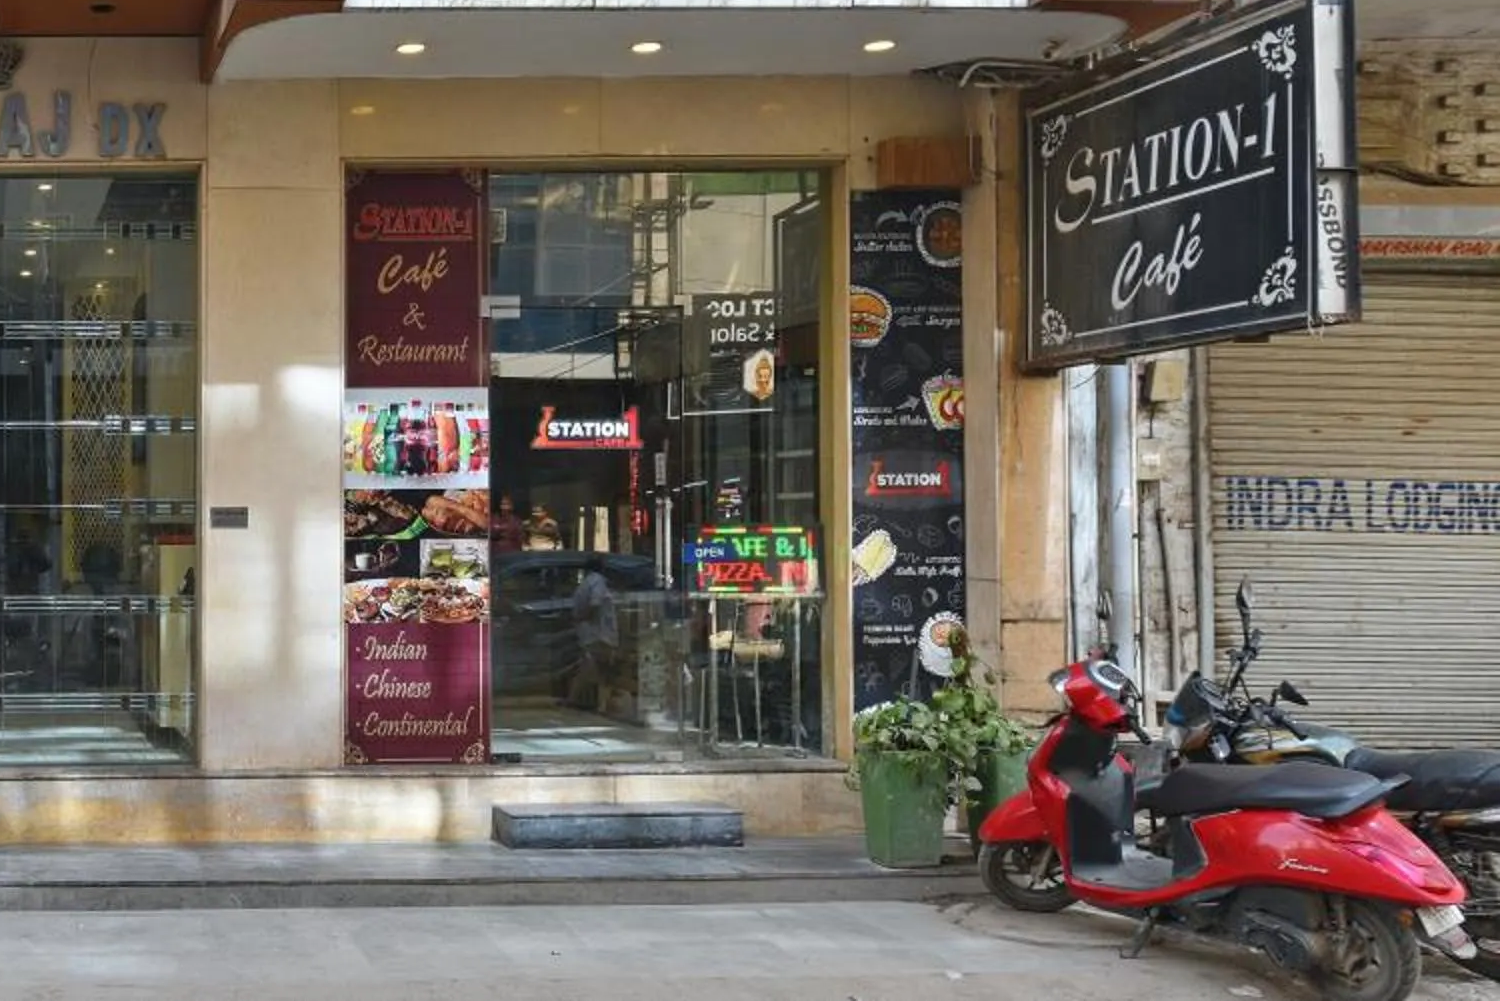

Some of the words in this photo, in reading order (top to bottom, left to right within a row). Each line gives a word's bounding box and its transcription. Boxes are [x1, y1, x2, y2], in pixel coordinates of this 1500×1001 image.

[99, 101, 169, 159] DX
[1055, 92, 1279, 233] STATION-1
[377, 248, 450, 295] Café
[1111, 213, 1203, 311] Café
[403, 302, 427, 331] &
[357, 334, 470, 366] Restaurant
[547, 421, 630, 438] STATION
[876, 472, 942, 487] STATION
[1225, 477, 1354, 532] INDRA
[694, 546, 725, 558] OPEN
[364, 630, 428, 661] Indian
[363, 668, 432, 699] Chinese
[363, 705, 475, 737] Continental
